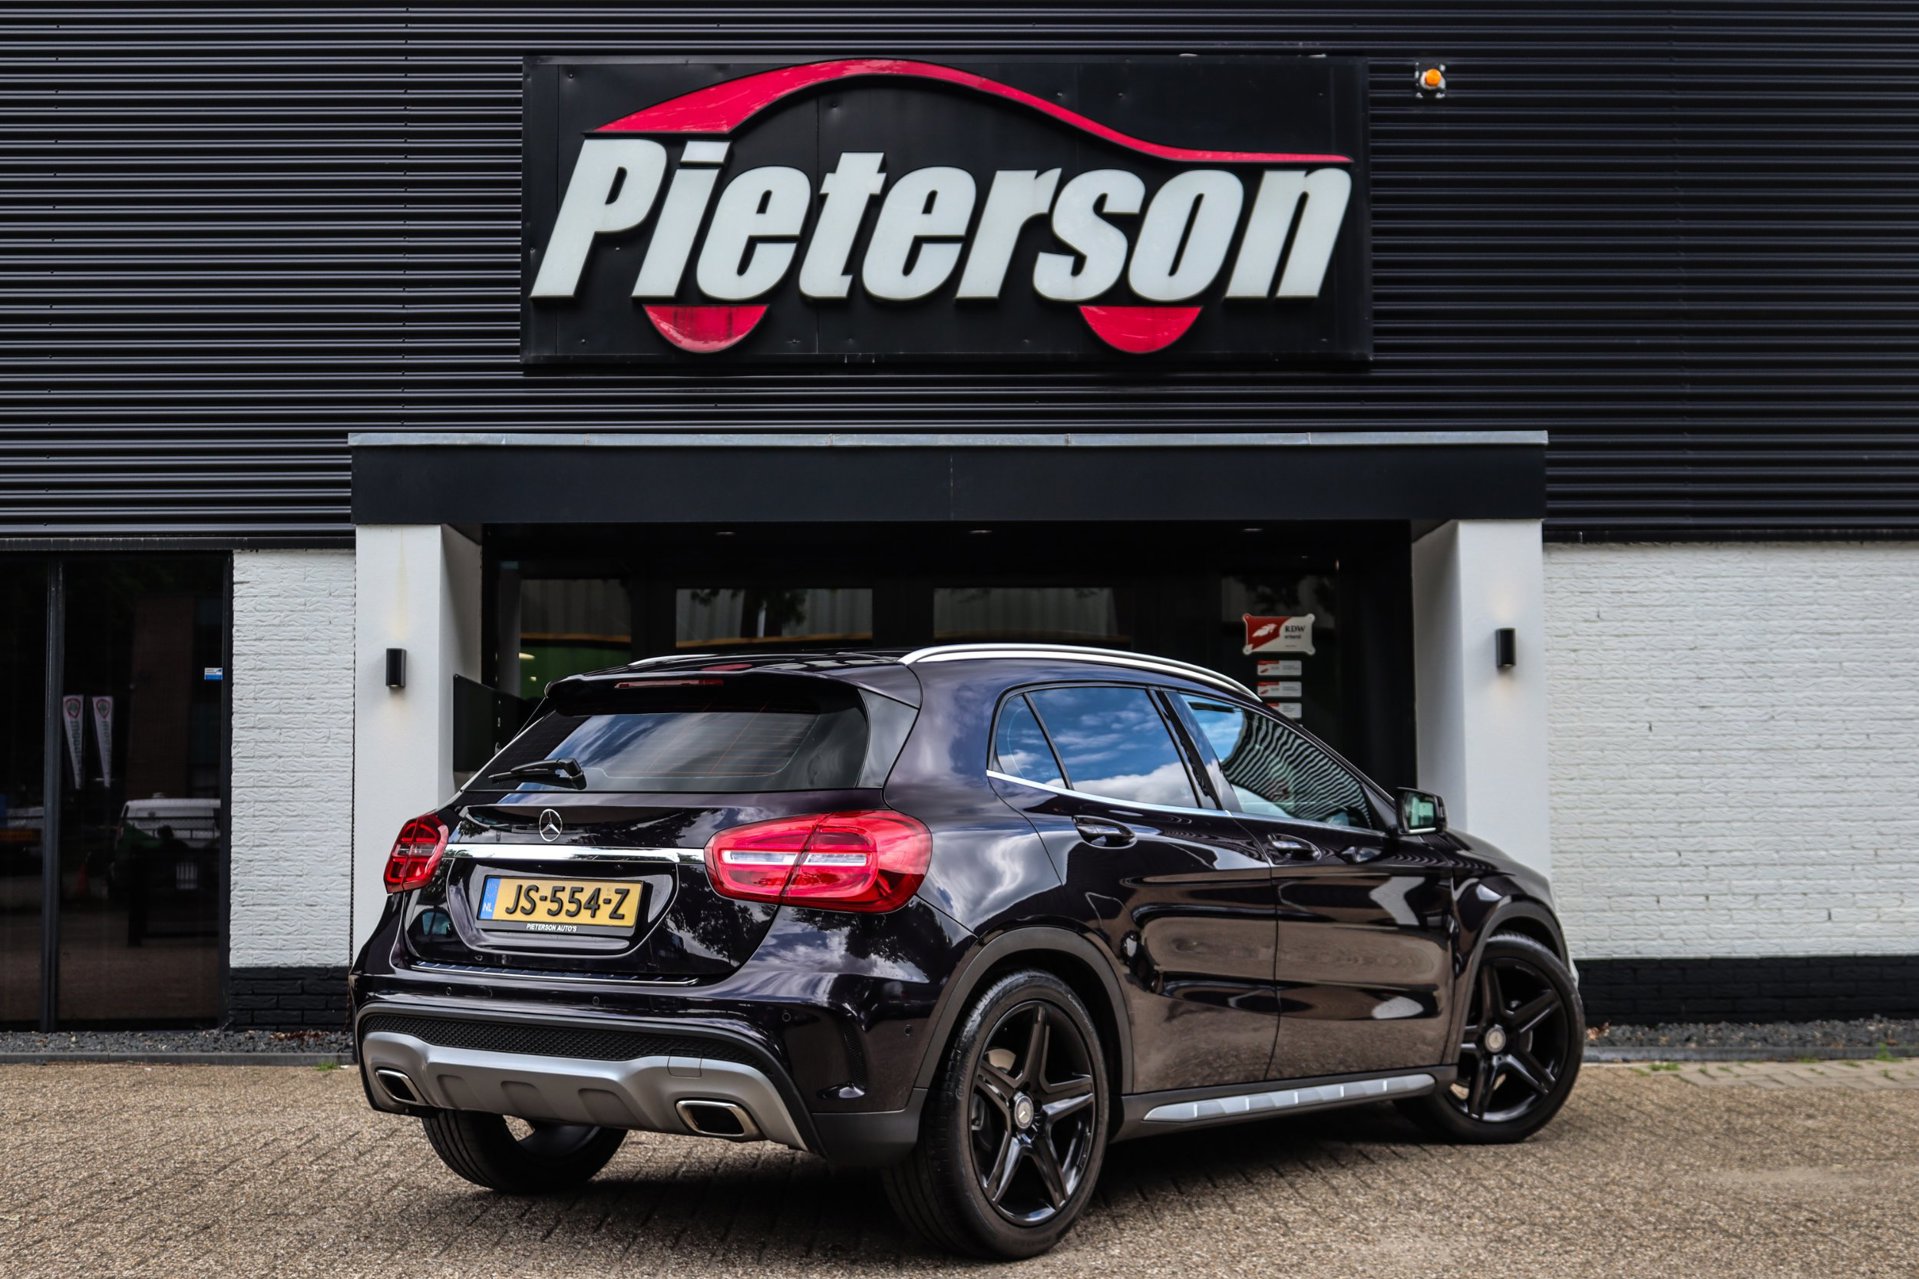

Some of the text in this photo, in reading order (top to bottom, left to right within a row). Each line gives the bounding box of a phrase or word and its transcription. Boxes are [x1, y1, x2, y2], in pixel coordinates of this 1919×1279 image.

[530, 138, 1353, 301] Pieterson
[482, 902, 493, 912] NL
[505, 884, 630, 920] JS-554-Z
[526, 923, 557, 931] PIETERSON
